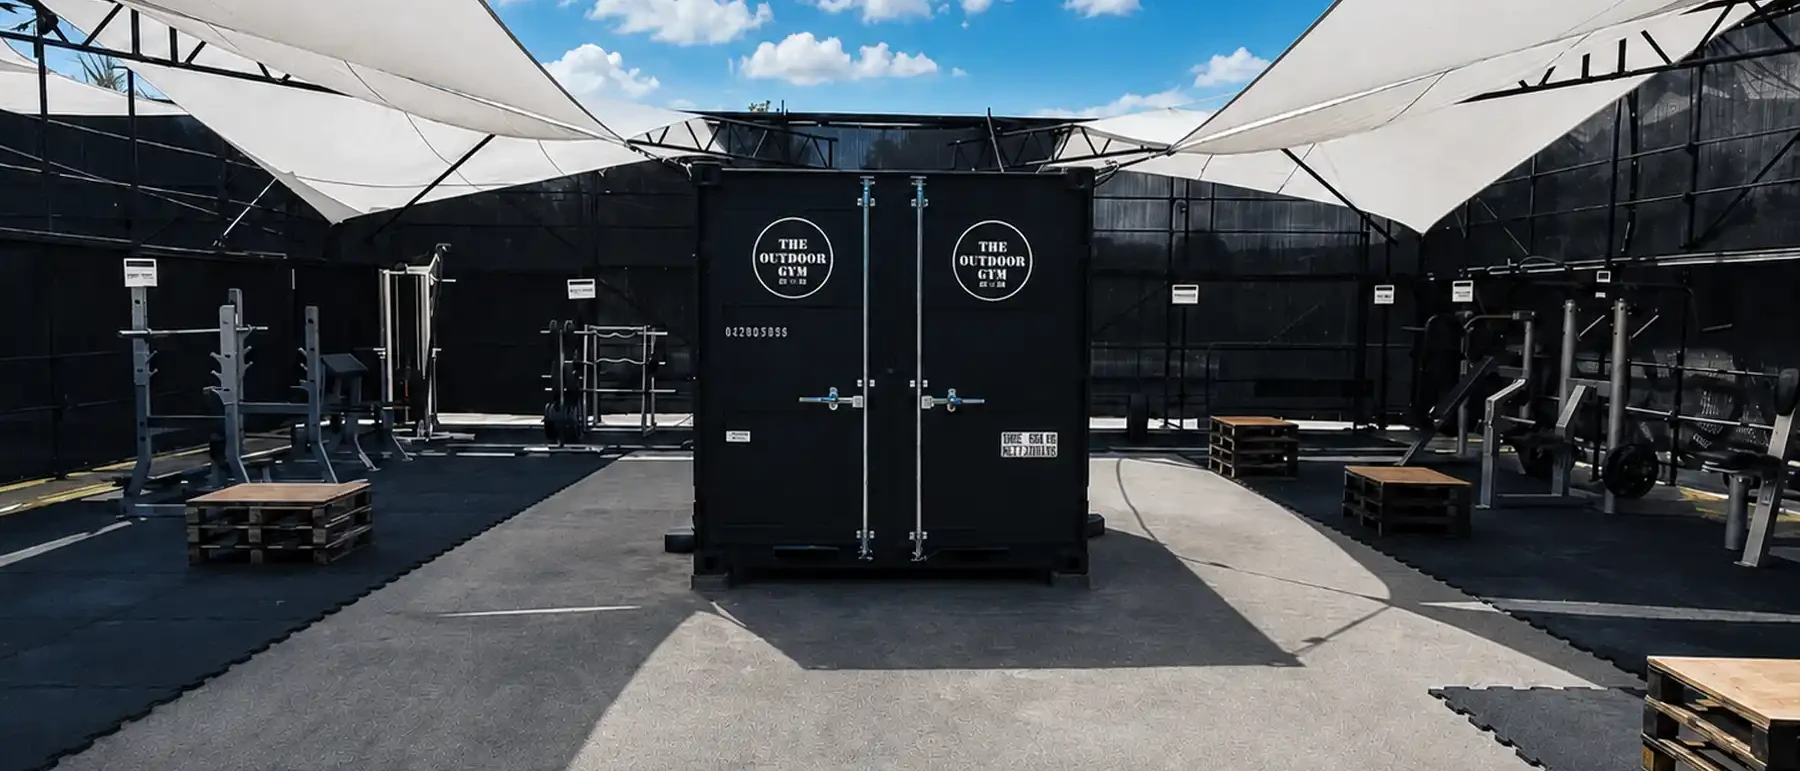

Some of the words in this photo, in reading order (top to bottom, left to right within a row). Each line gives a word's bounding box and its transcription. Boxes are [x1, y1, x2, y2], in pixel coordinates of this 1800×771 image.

[778, 238, 808, 250] THE
[978, 241, 1008, 253] THE
[759, 252, 827, 264] OUTDOOR
[959, 255, 1026, 267] OUTDOOR
[777, 266, 808, 277] GYM
[977, 268, 1007, 280] GYM
